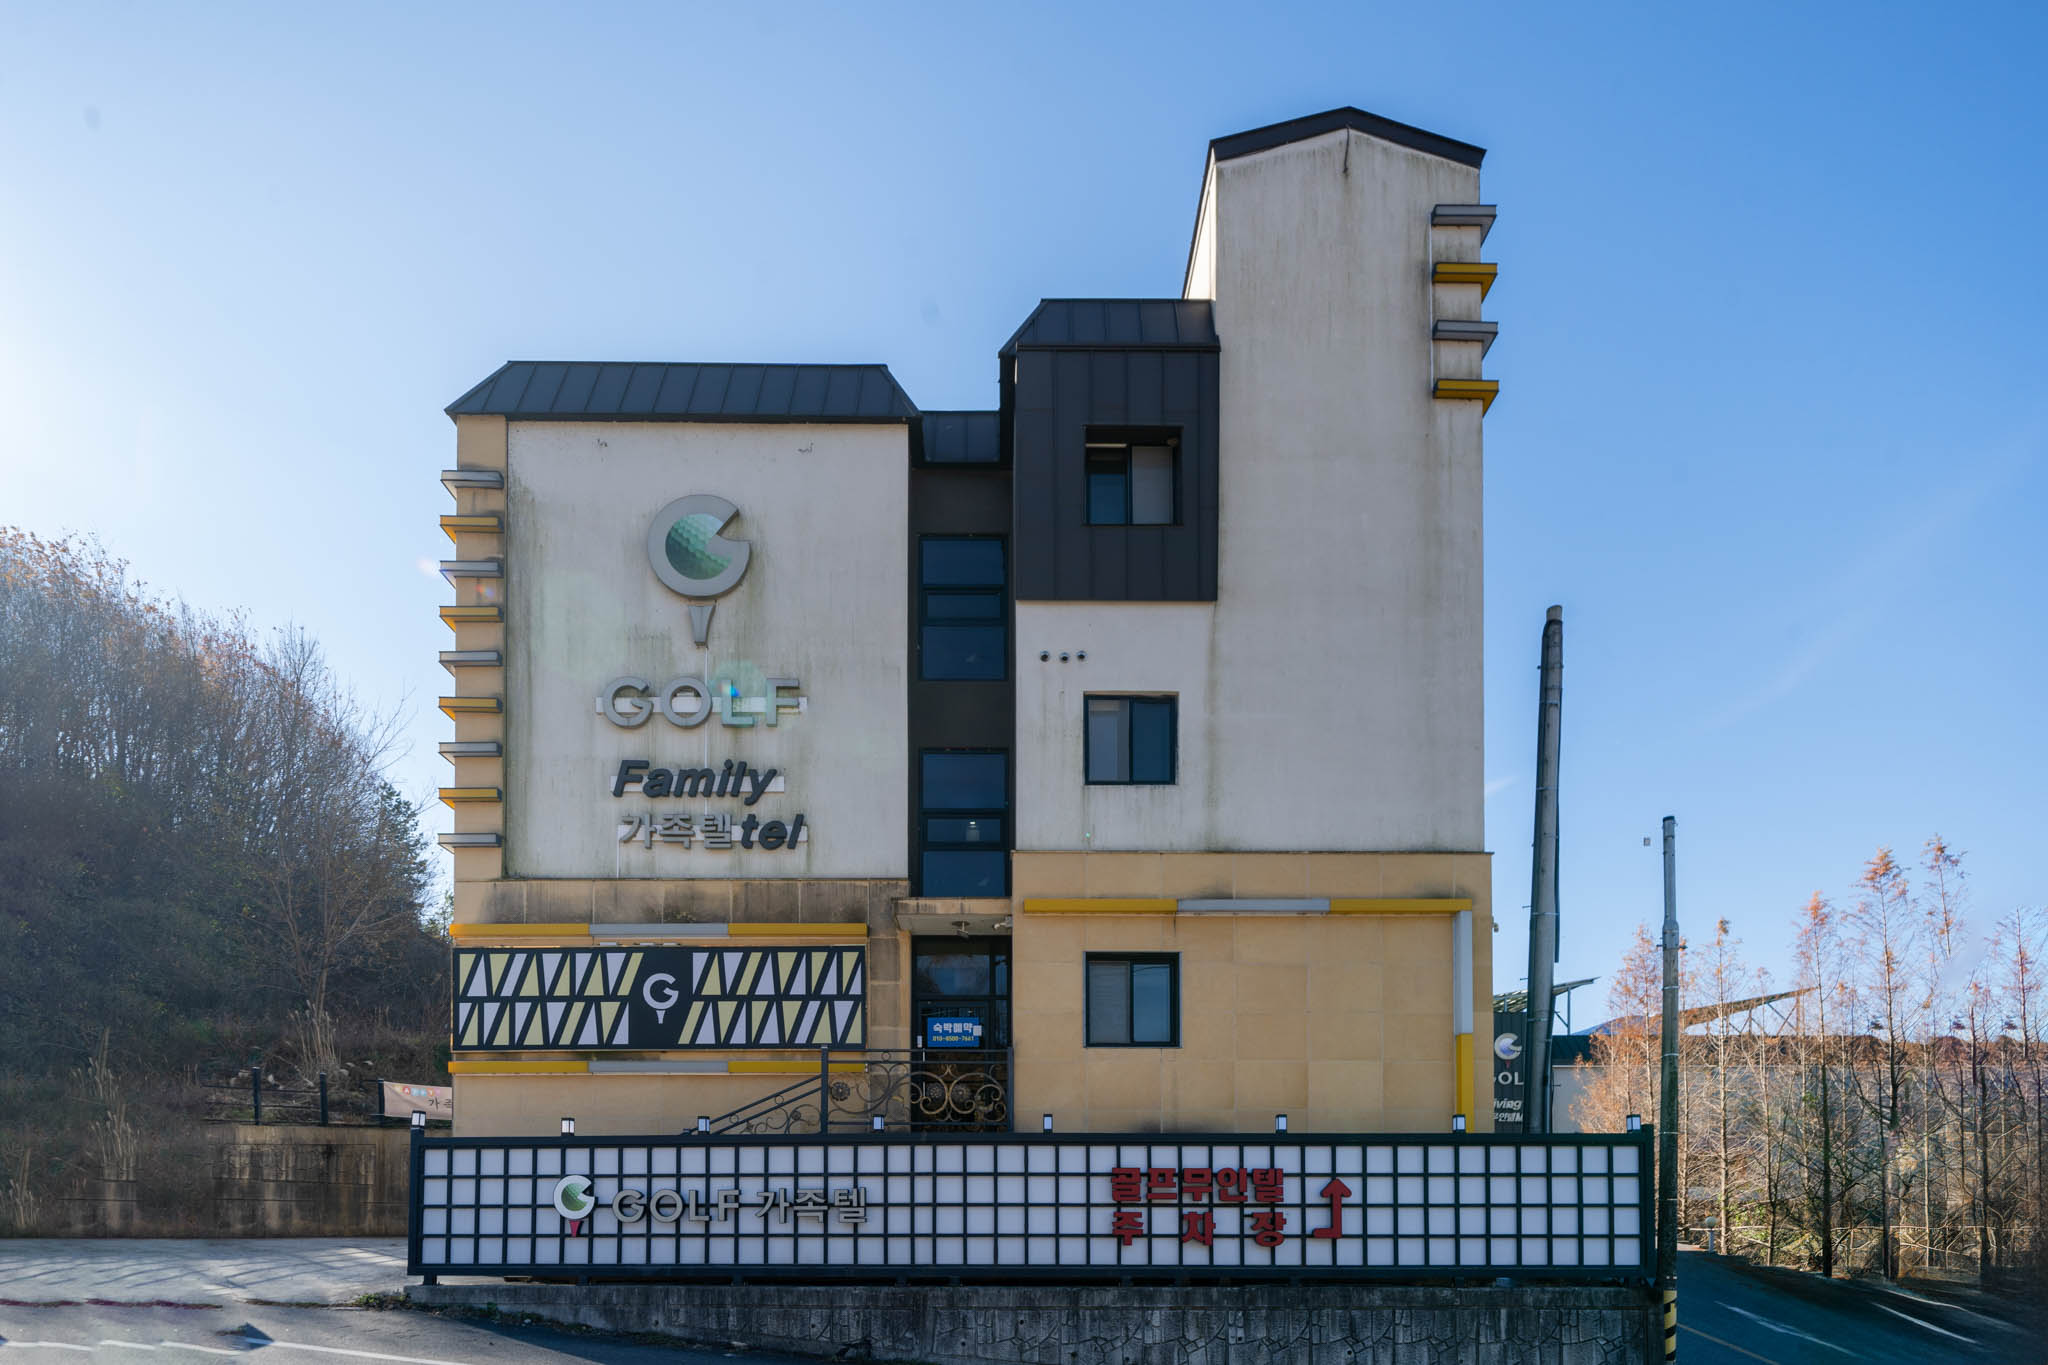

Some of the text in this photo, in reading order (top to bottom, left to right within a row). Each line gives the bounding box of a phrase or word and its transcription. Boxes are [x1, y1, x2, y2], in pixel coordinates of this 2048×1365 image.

[601, 676, 800, 729] GOLF
[613, 759, 777, 806] Family
[1494, 1071, 1524, 1086] OL
[1111, 1167, 1284, 1202] 골프무인빌
[612, 1188, 741, 1224] GOLF
[755, 1187, 868, 1225] 가족텔
